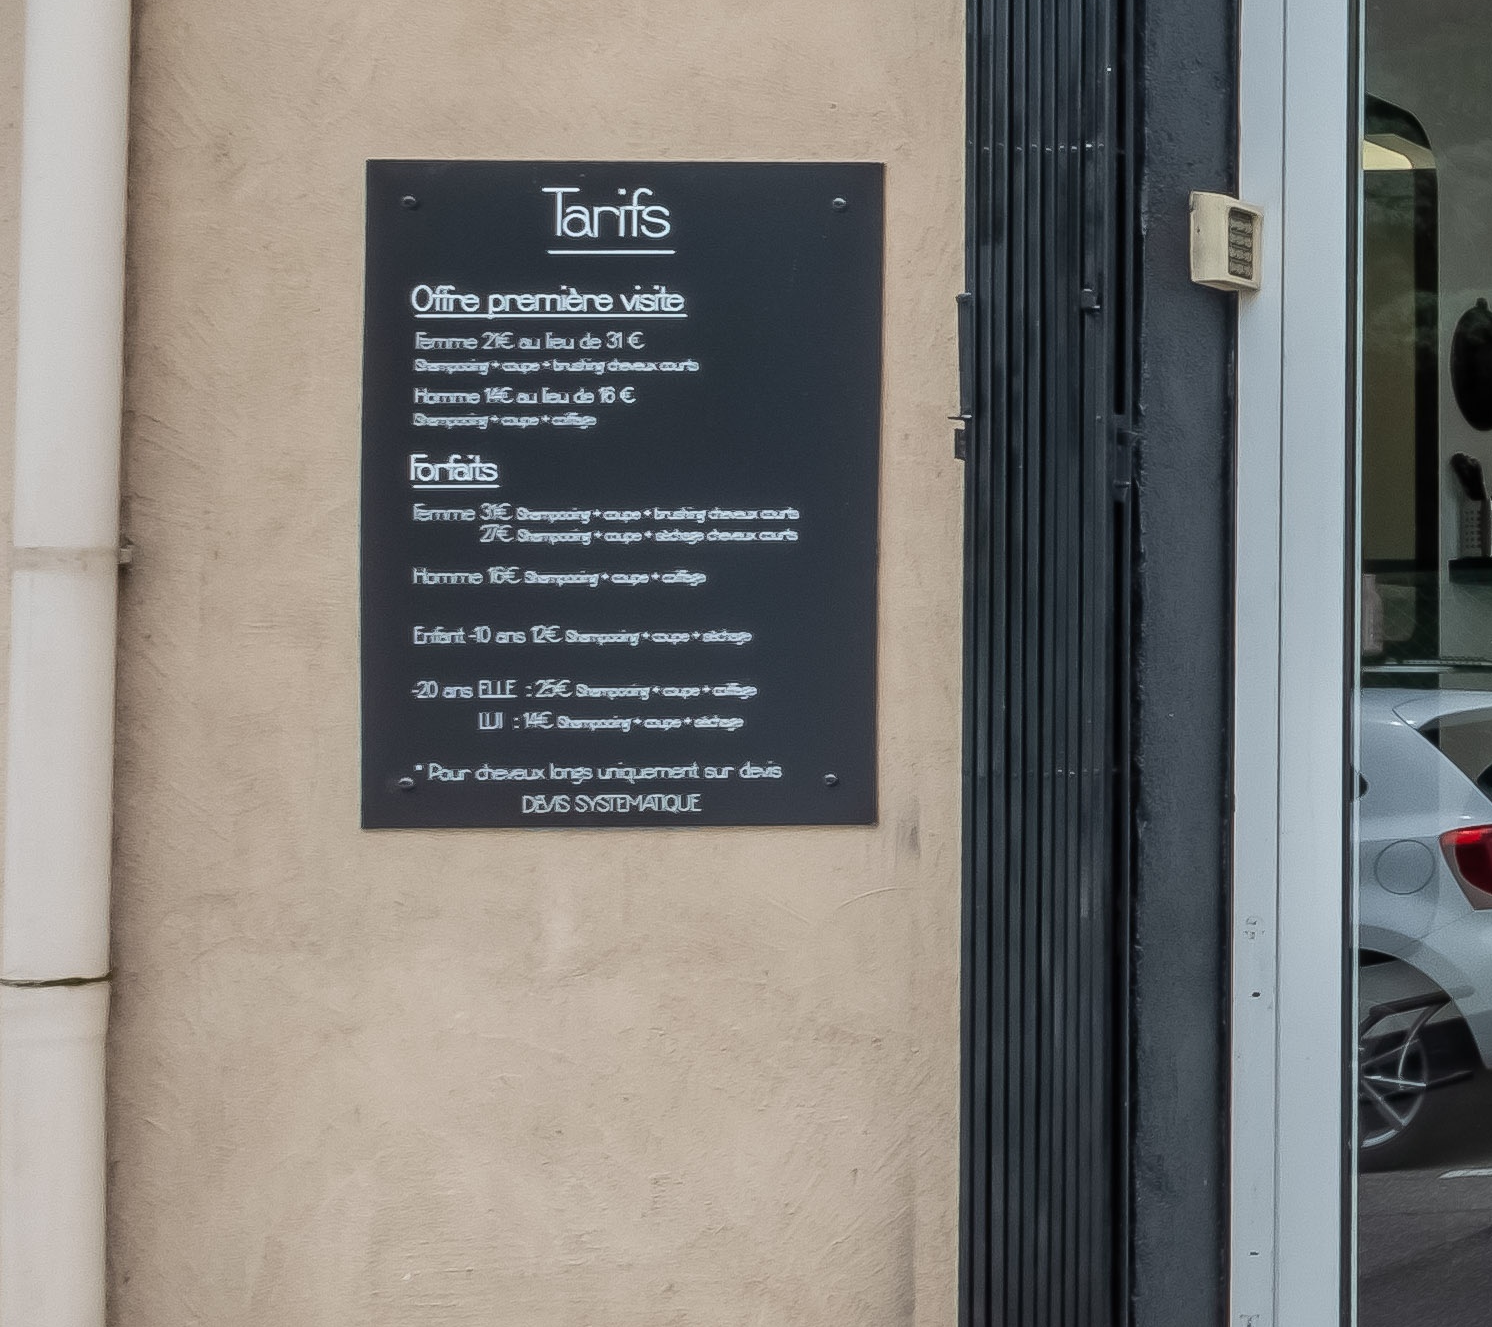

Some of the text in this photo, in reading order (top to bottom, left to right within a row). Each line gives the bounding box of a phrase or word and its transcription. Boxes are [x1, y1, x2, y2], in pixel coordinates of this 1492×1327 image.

[541, 187, 672, 238] Tarifs
[411, 284, 685, 319] Offre première visite
[606, 332, 624, 349] 31
[628, 332, 646, 350] €
[619, 386, 637, 404] €
[409, 454, 499, 481] Forfaits
[428, 763, 472, 781] Pour
[704, 767, 735, 779] sur
